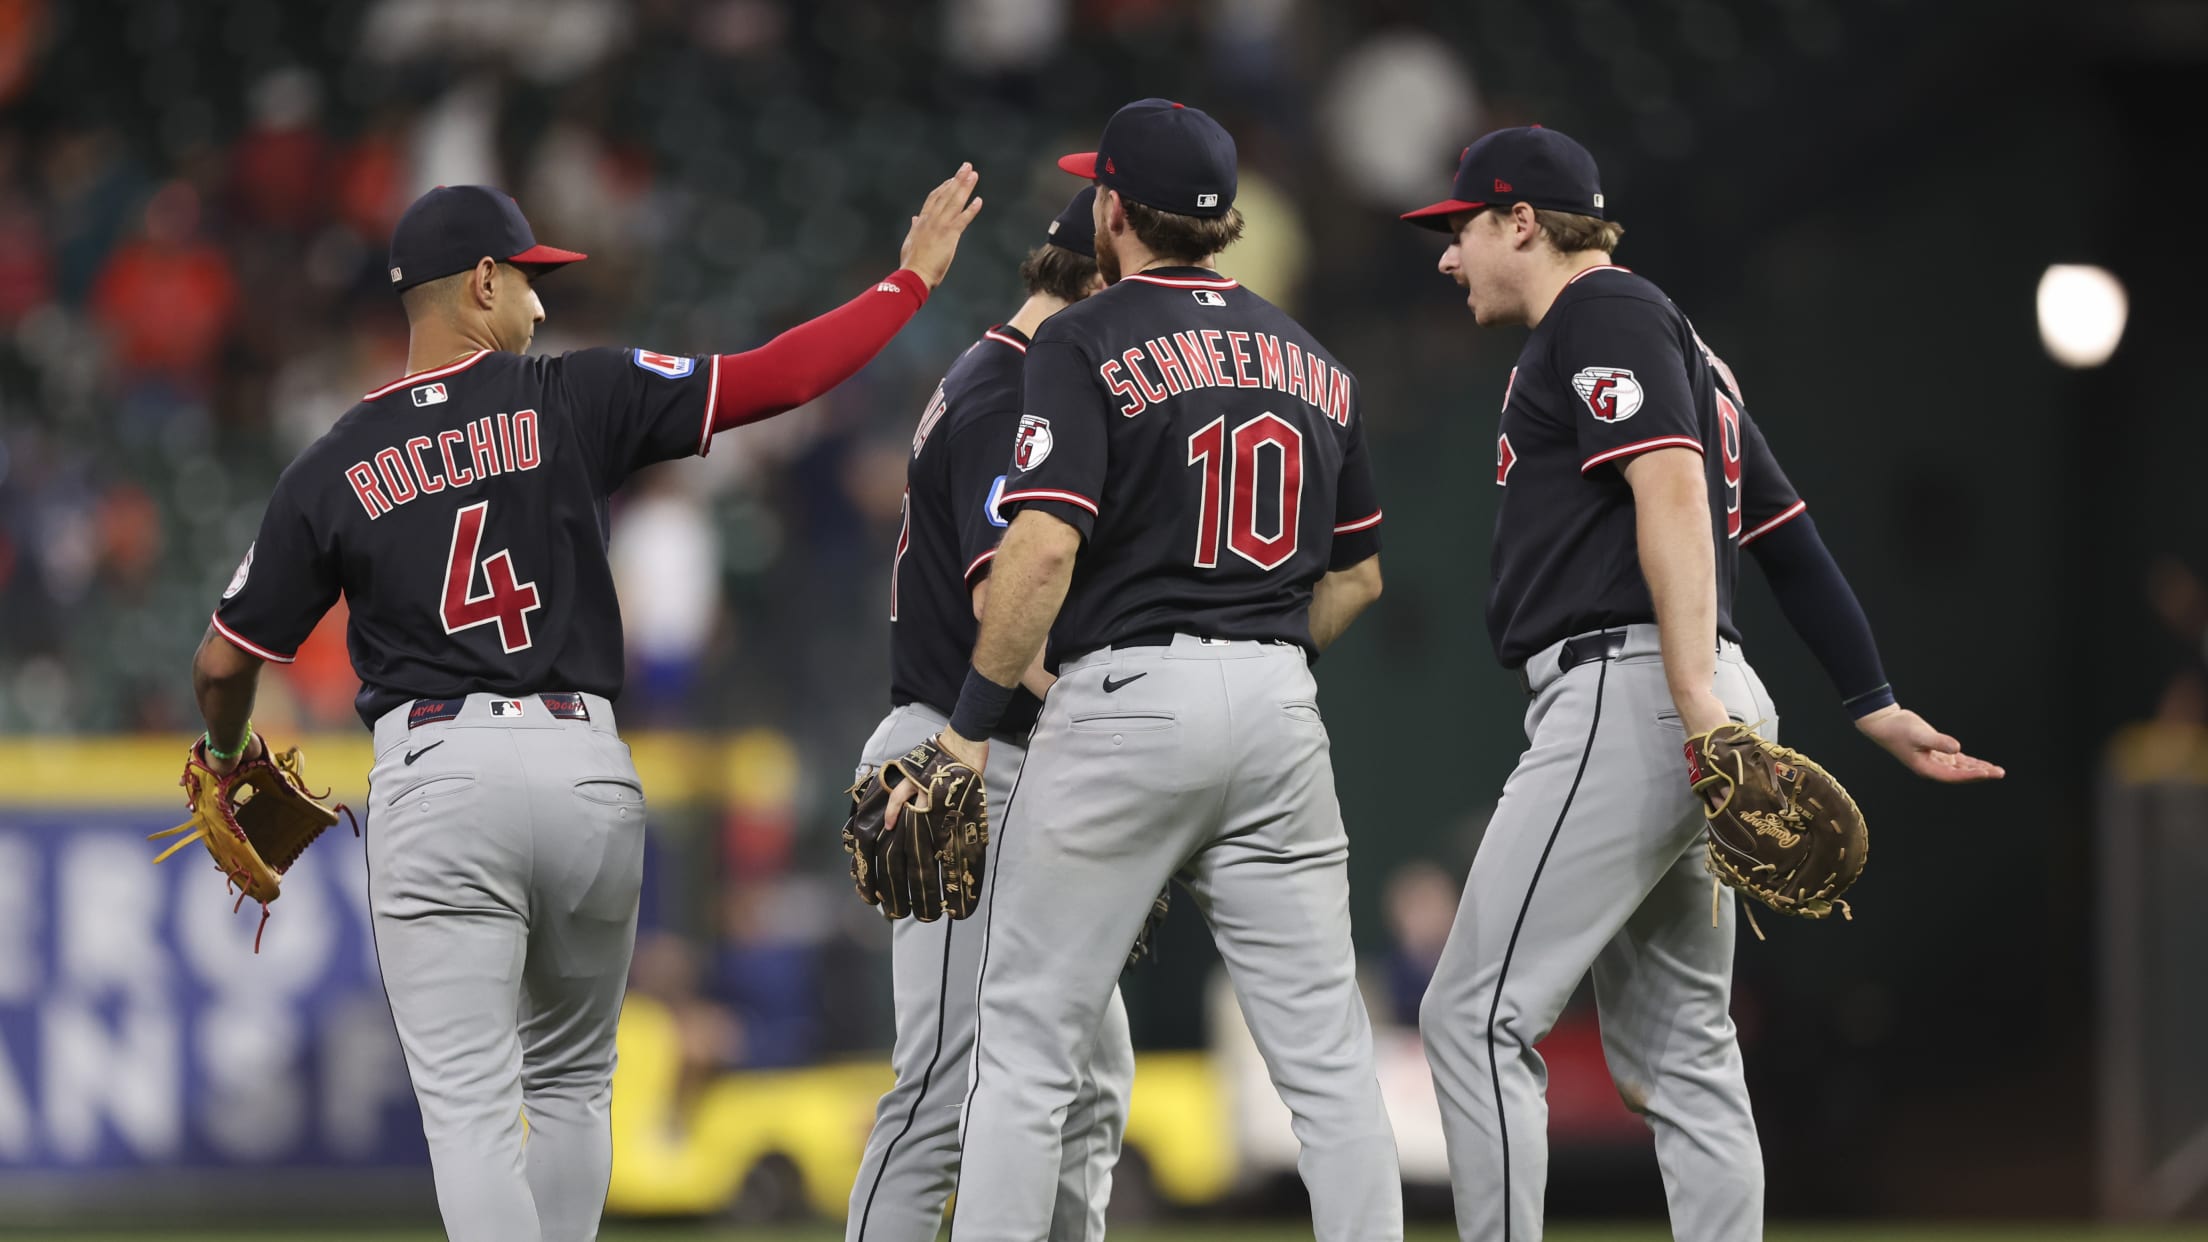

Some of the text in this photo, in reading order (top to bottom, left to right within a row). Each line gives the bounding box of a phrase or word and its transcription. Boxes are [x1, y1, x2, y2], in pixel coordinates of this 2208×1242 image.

[1101, 329, 1350, 428] SCHNEEMANN
[345, 409, 541, 520] ROCCHIO
[1187, 411, 1304, 572] 10
[1715, 387, 1742, 540] 9
[439, 500, 541, 655] 4
